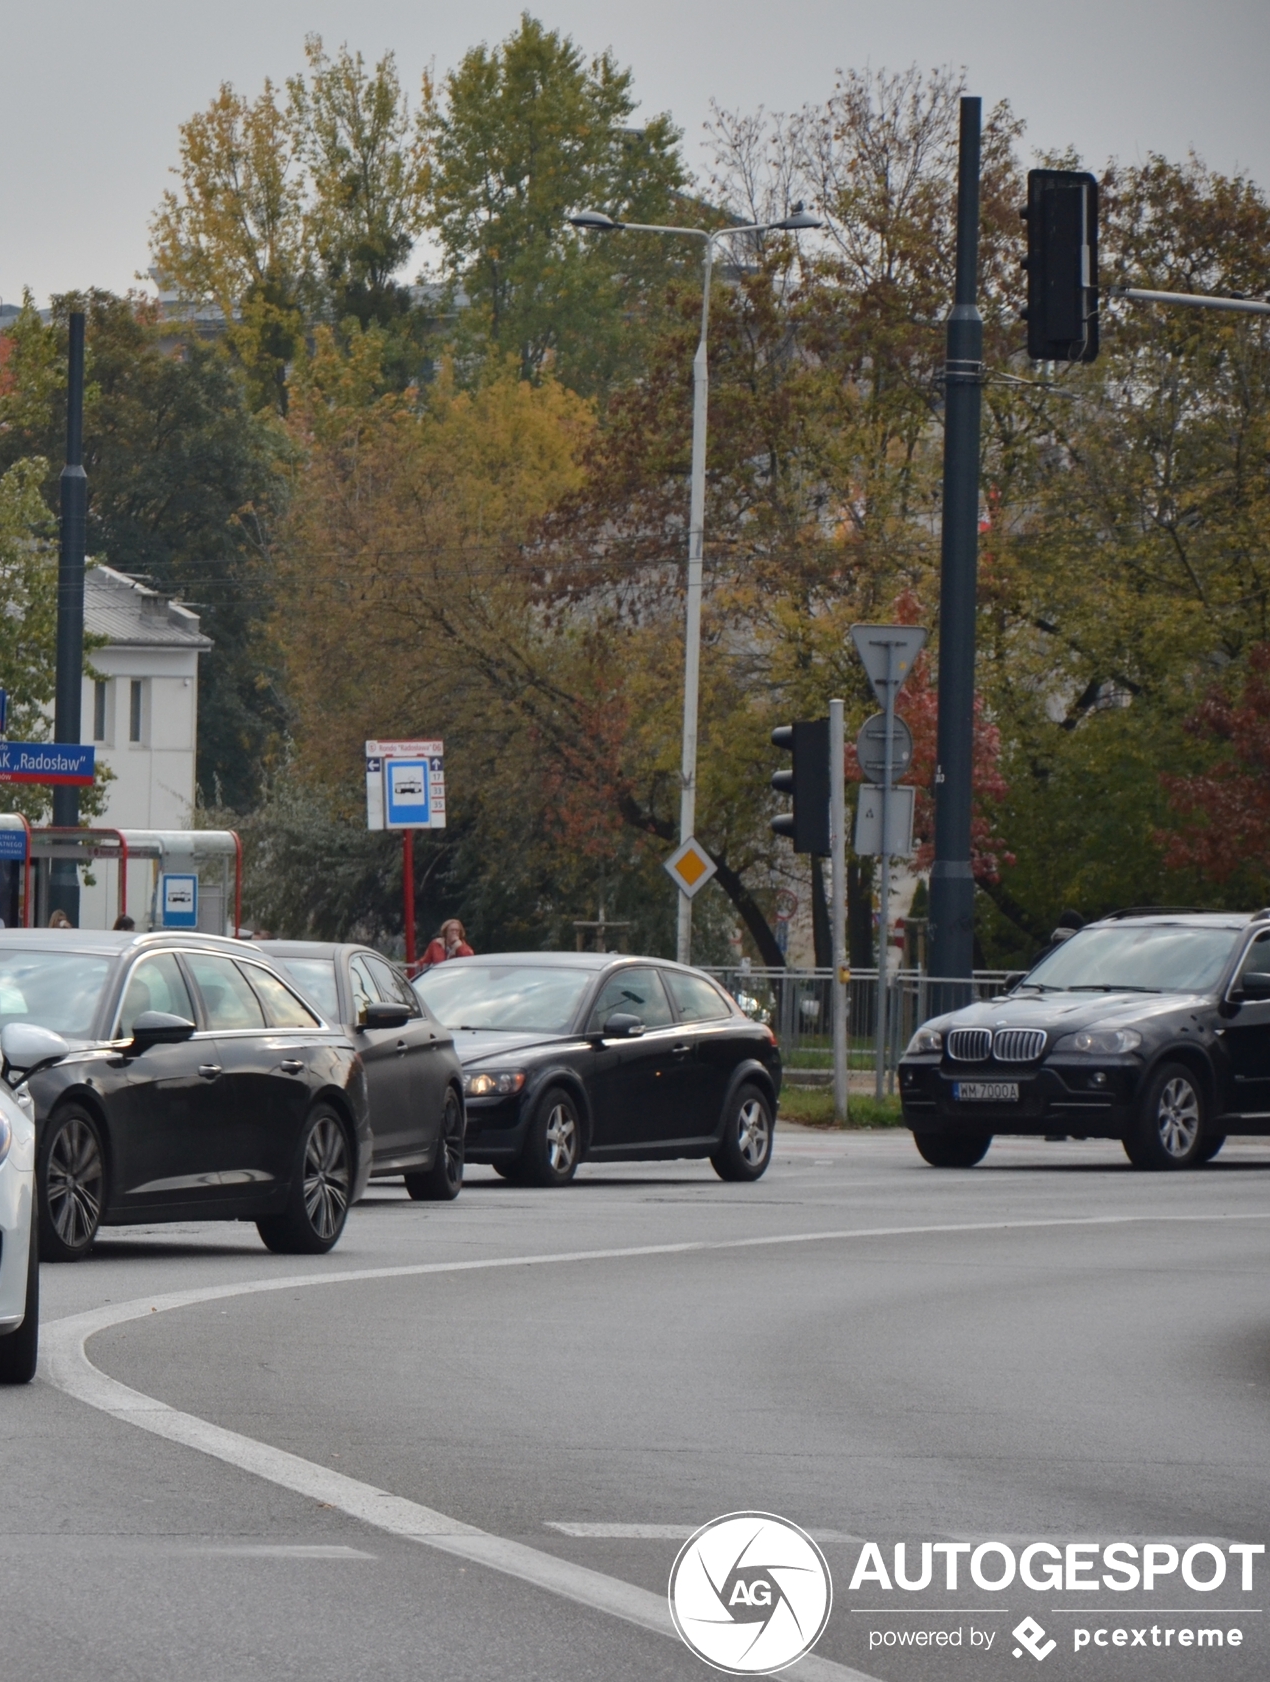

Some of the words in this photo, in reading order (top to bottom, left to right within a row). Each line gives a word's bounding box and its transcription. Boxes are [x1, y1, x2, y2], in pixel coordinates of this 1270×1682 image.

[433, 773, 441, 781] 17
[960, 1083, 976, 1098] WM
[980, 1084, 1016, 1098] 7000A
